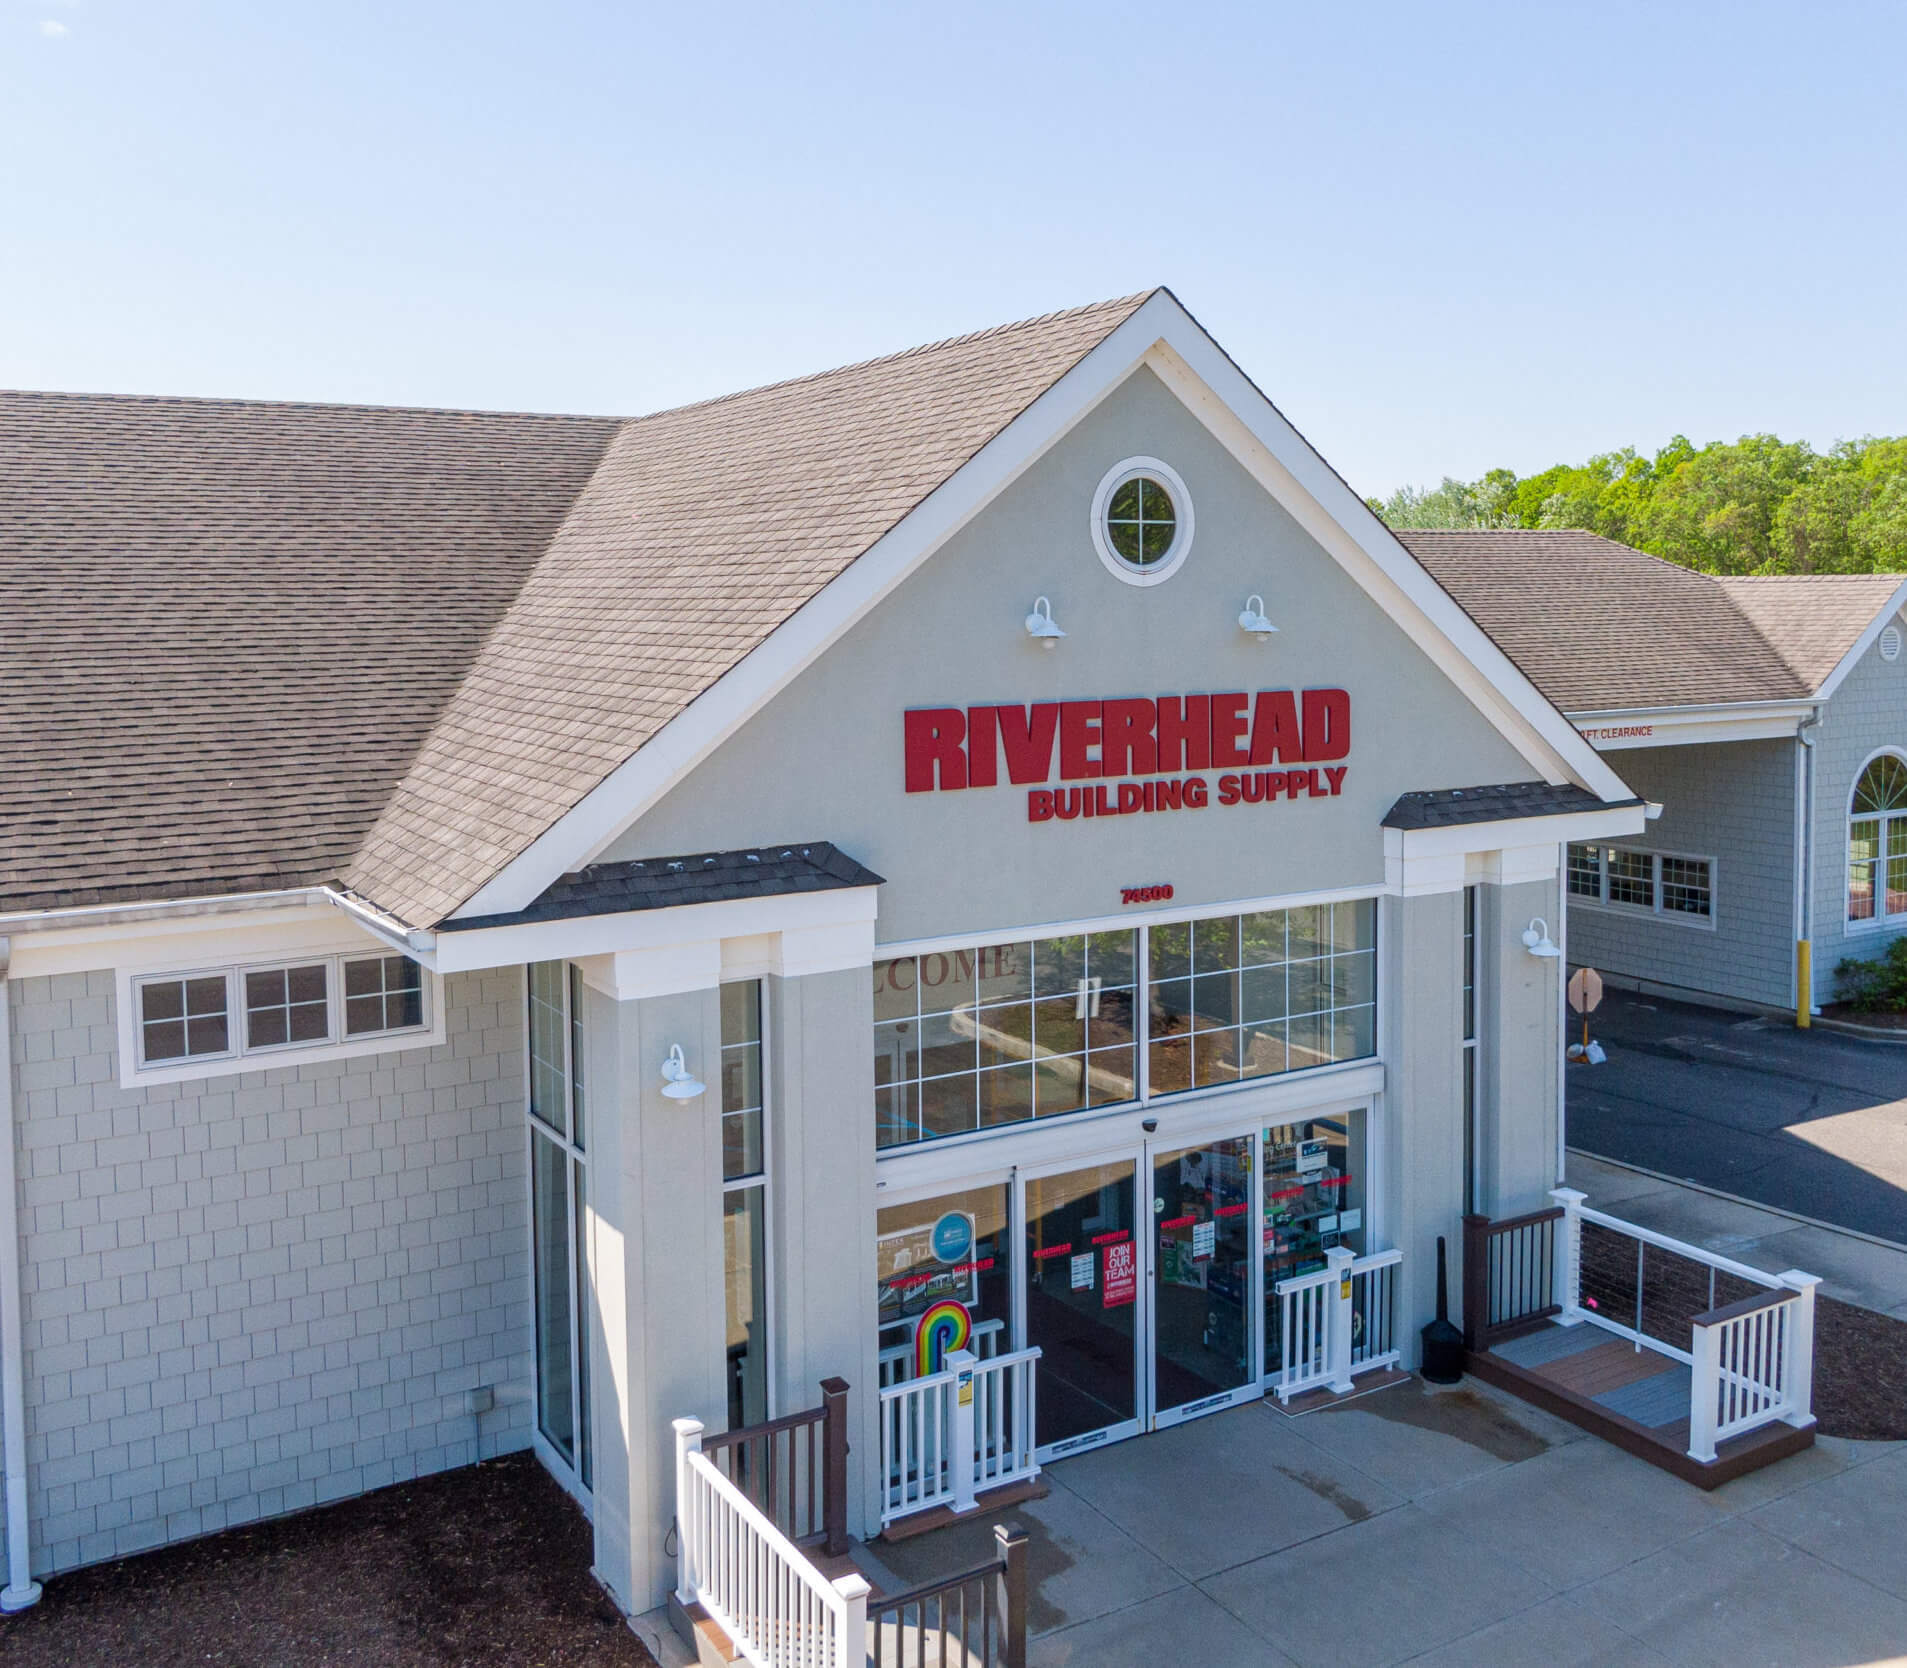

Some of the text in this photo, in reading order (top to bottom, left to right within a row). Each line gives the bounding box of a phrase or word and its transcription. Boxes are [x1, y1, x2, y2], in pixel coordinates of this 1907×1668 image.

[904, 688, 1350, 793] RIVERHEAD
[1601, 726, 1653, 739] CLEARANCE
[1028, 766, 1348, 823] BUILDING SUPPLY
[1120, 884, 1173, 905] 74500
[1109, 1243, 1131, 1258] JOIN
[1109, 1255, 1130, 1268] OUR
[1104, 1264, 1135, 1280] TEAM
